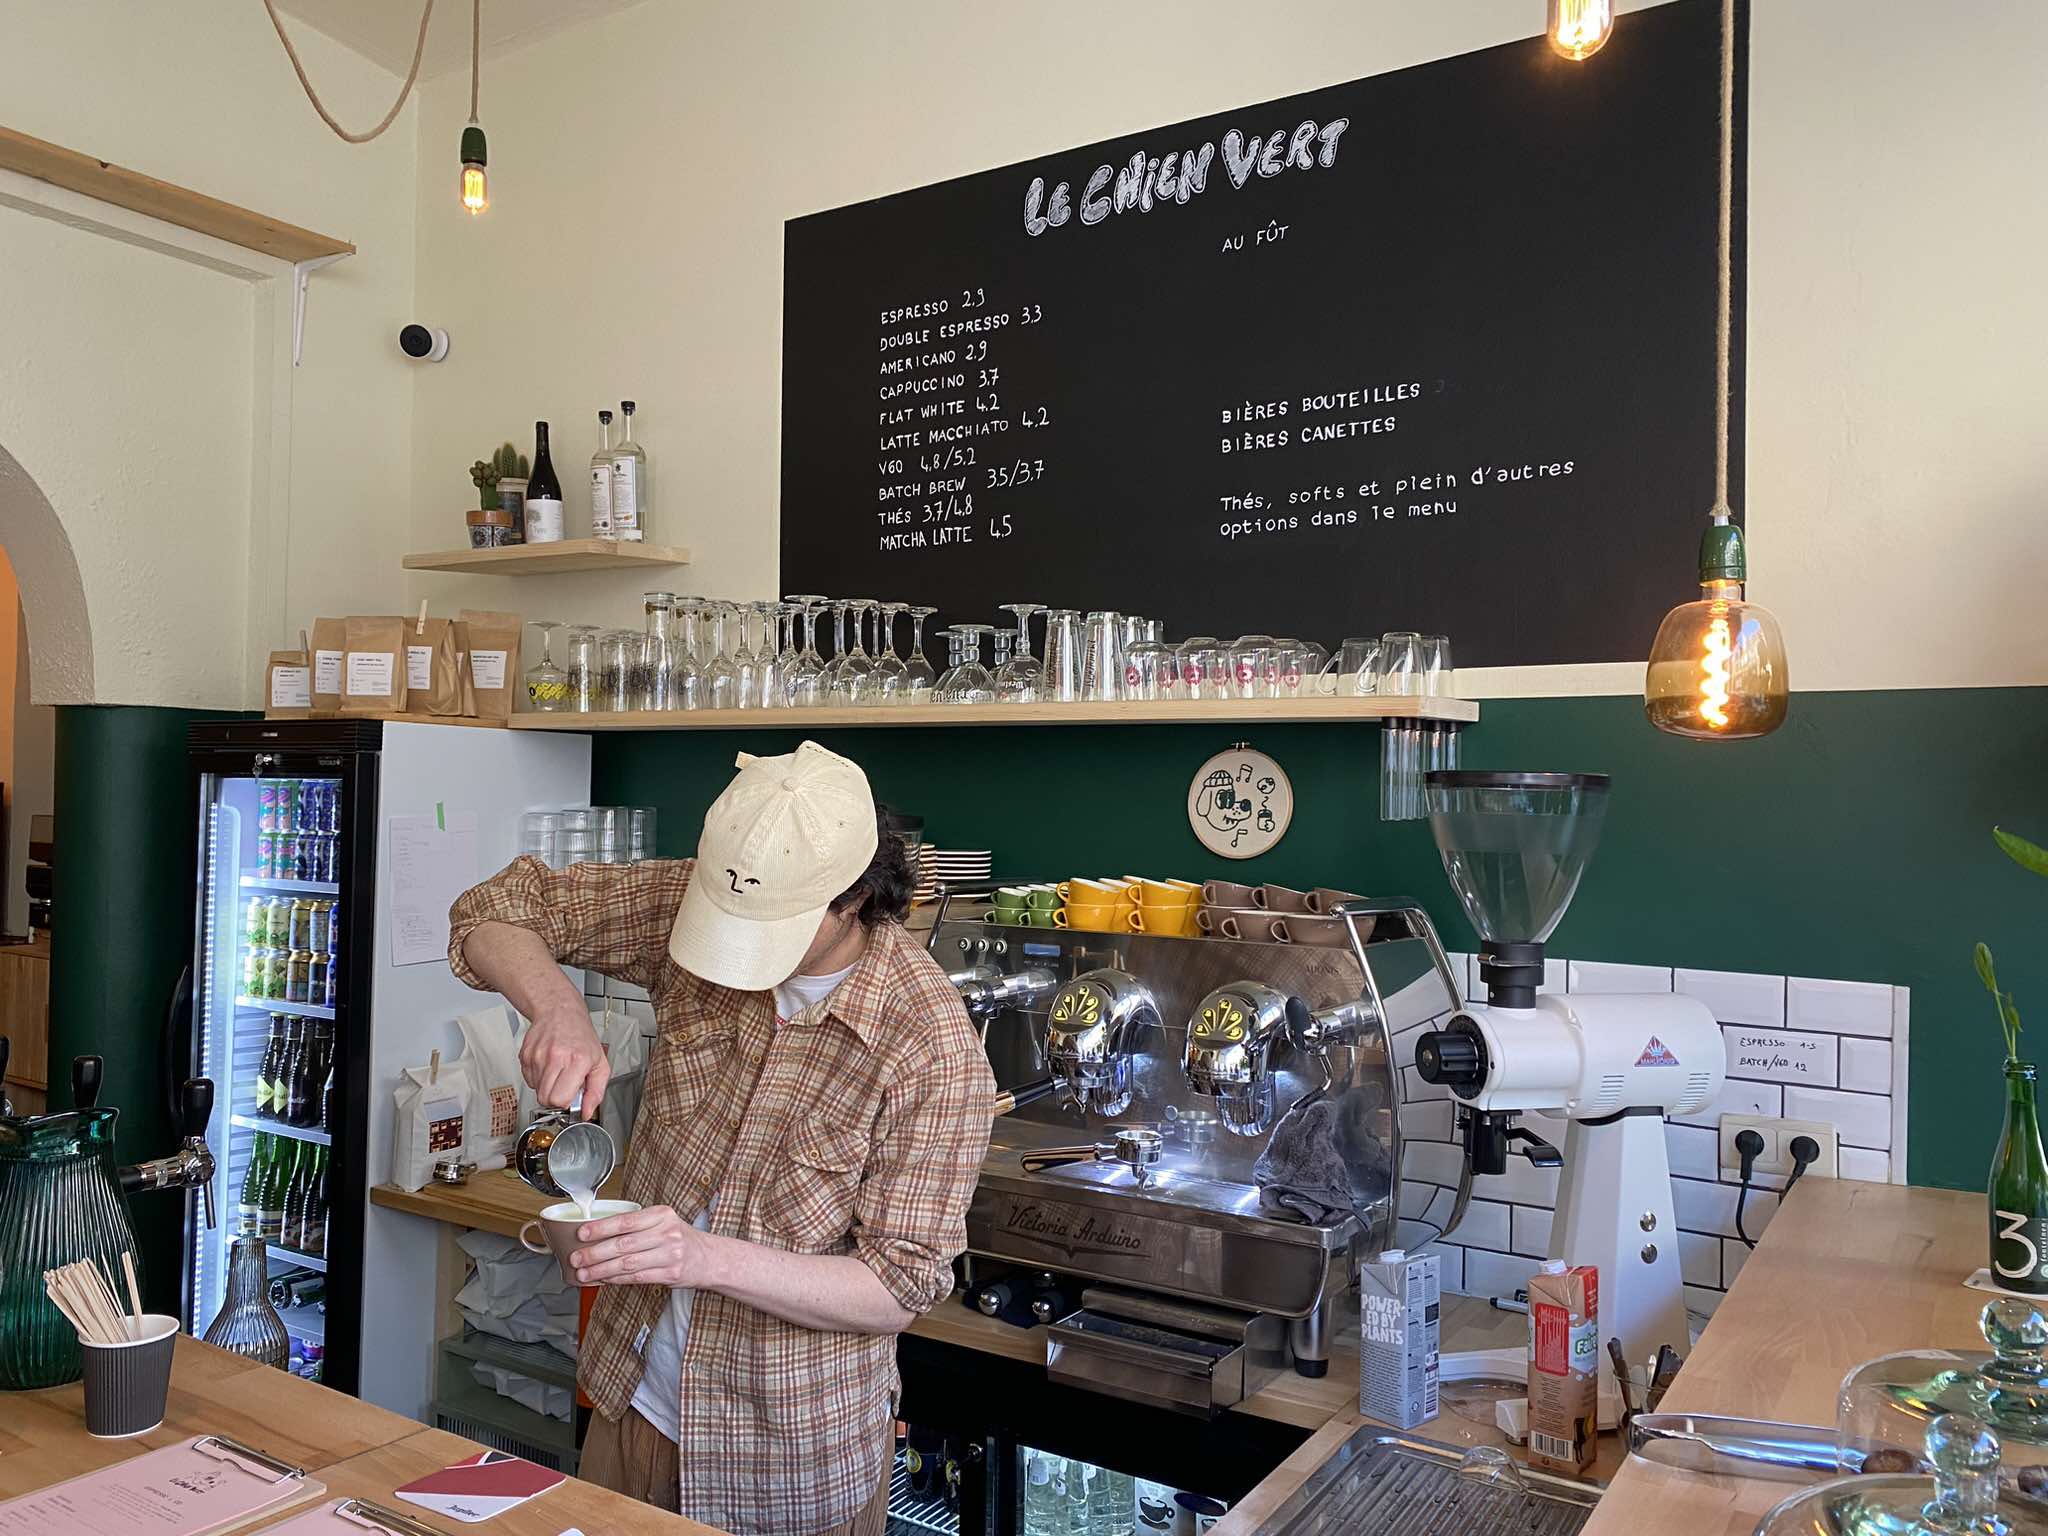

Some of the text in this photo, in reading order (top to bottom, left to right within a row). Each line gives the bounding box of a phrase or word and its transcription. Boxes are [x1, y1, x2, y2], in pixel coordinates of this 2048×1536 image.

[1024, 177, 1071, 236] LE
[1221, 118, 1349, 189] VERT
[1222, 220, 1288, 252] AU FÛT
[882, 300, 948, 324] ESPRESSO
[881, 330, 929, 351] DOUBLE
[941, 314, 1009, 337] ESPRESSO
[881, 351, 955, 374] AMERICANO
[880, 374, 964, 399] CAPPUCCINO
[880, 409, 913, 424] FLAT
[921, 400, 965, 418] WHITE
[1223, 383, 1420, 423] BIÈRES BOUTEILLES
[881, 432, 920, 450] LATTE
[929, 421, 1008, 443] MACCHIATO
[1222, 417, 1395, 453] BIÈRES CANETTES
[879, 460, 902, 474] V60
[879, 484, 920, 500] BATCH
[930, 477, 966, 494] BREW
[1221, 492, 1271, 510] Thés,
[1289, 487, 1344, 503] softs
[1359, 481, 1380, 496] et
[1397, 473, 1456, 495] plein
[878, 508, 911, 525] THÉS
[1221, 502, 1456, 539] options dans le menu
[880, 531, 927, 550] MATCHA
[934, 526, 972, 545] LATTE
[1739, 1037, 1785, 1047] ESPRESSO
[1794, 1062, 1807, 1072] 12
[1007, 1205, 1141, 1250] Victoria Arduino
[1995, 1210, 2038, 1278] 3
[1361, 1293, 1406, 1316] POWER-
[1366, 1310, 1397, 1329] ED BY
[1361, 1323, 1404, 1346] PLANTS
